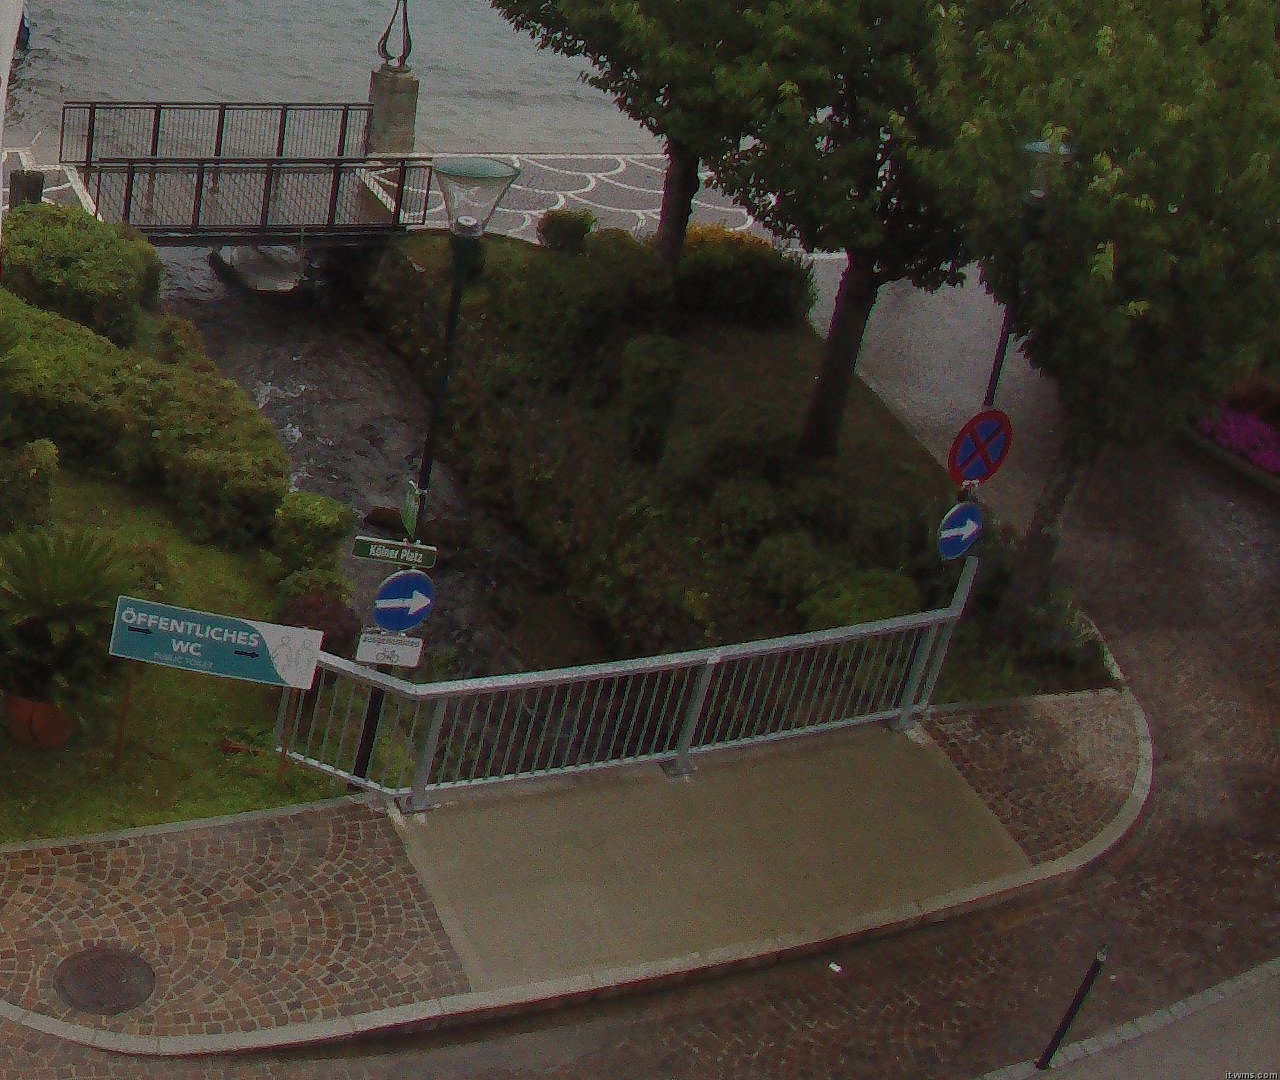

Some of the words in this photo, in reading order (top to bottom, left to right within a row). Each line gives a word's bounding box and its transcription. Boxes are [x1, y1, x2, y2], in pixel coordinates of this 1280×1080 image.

[369, 544, 400, 559] Kölner
[400, 548, 424, 563] Platz
[121, 607, 260, 648] ÖFFENTLICHES
[171, 638, 202, 657] WC
